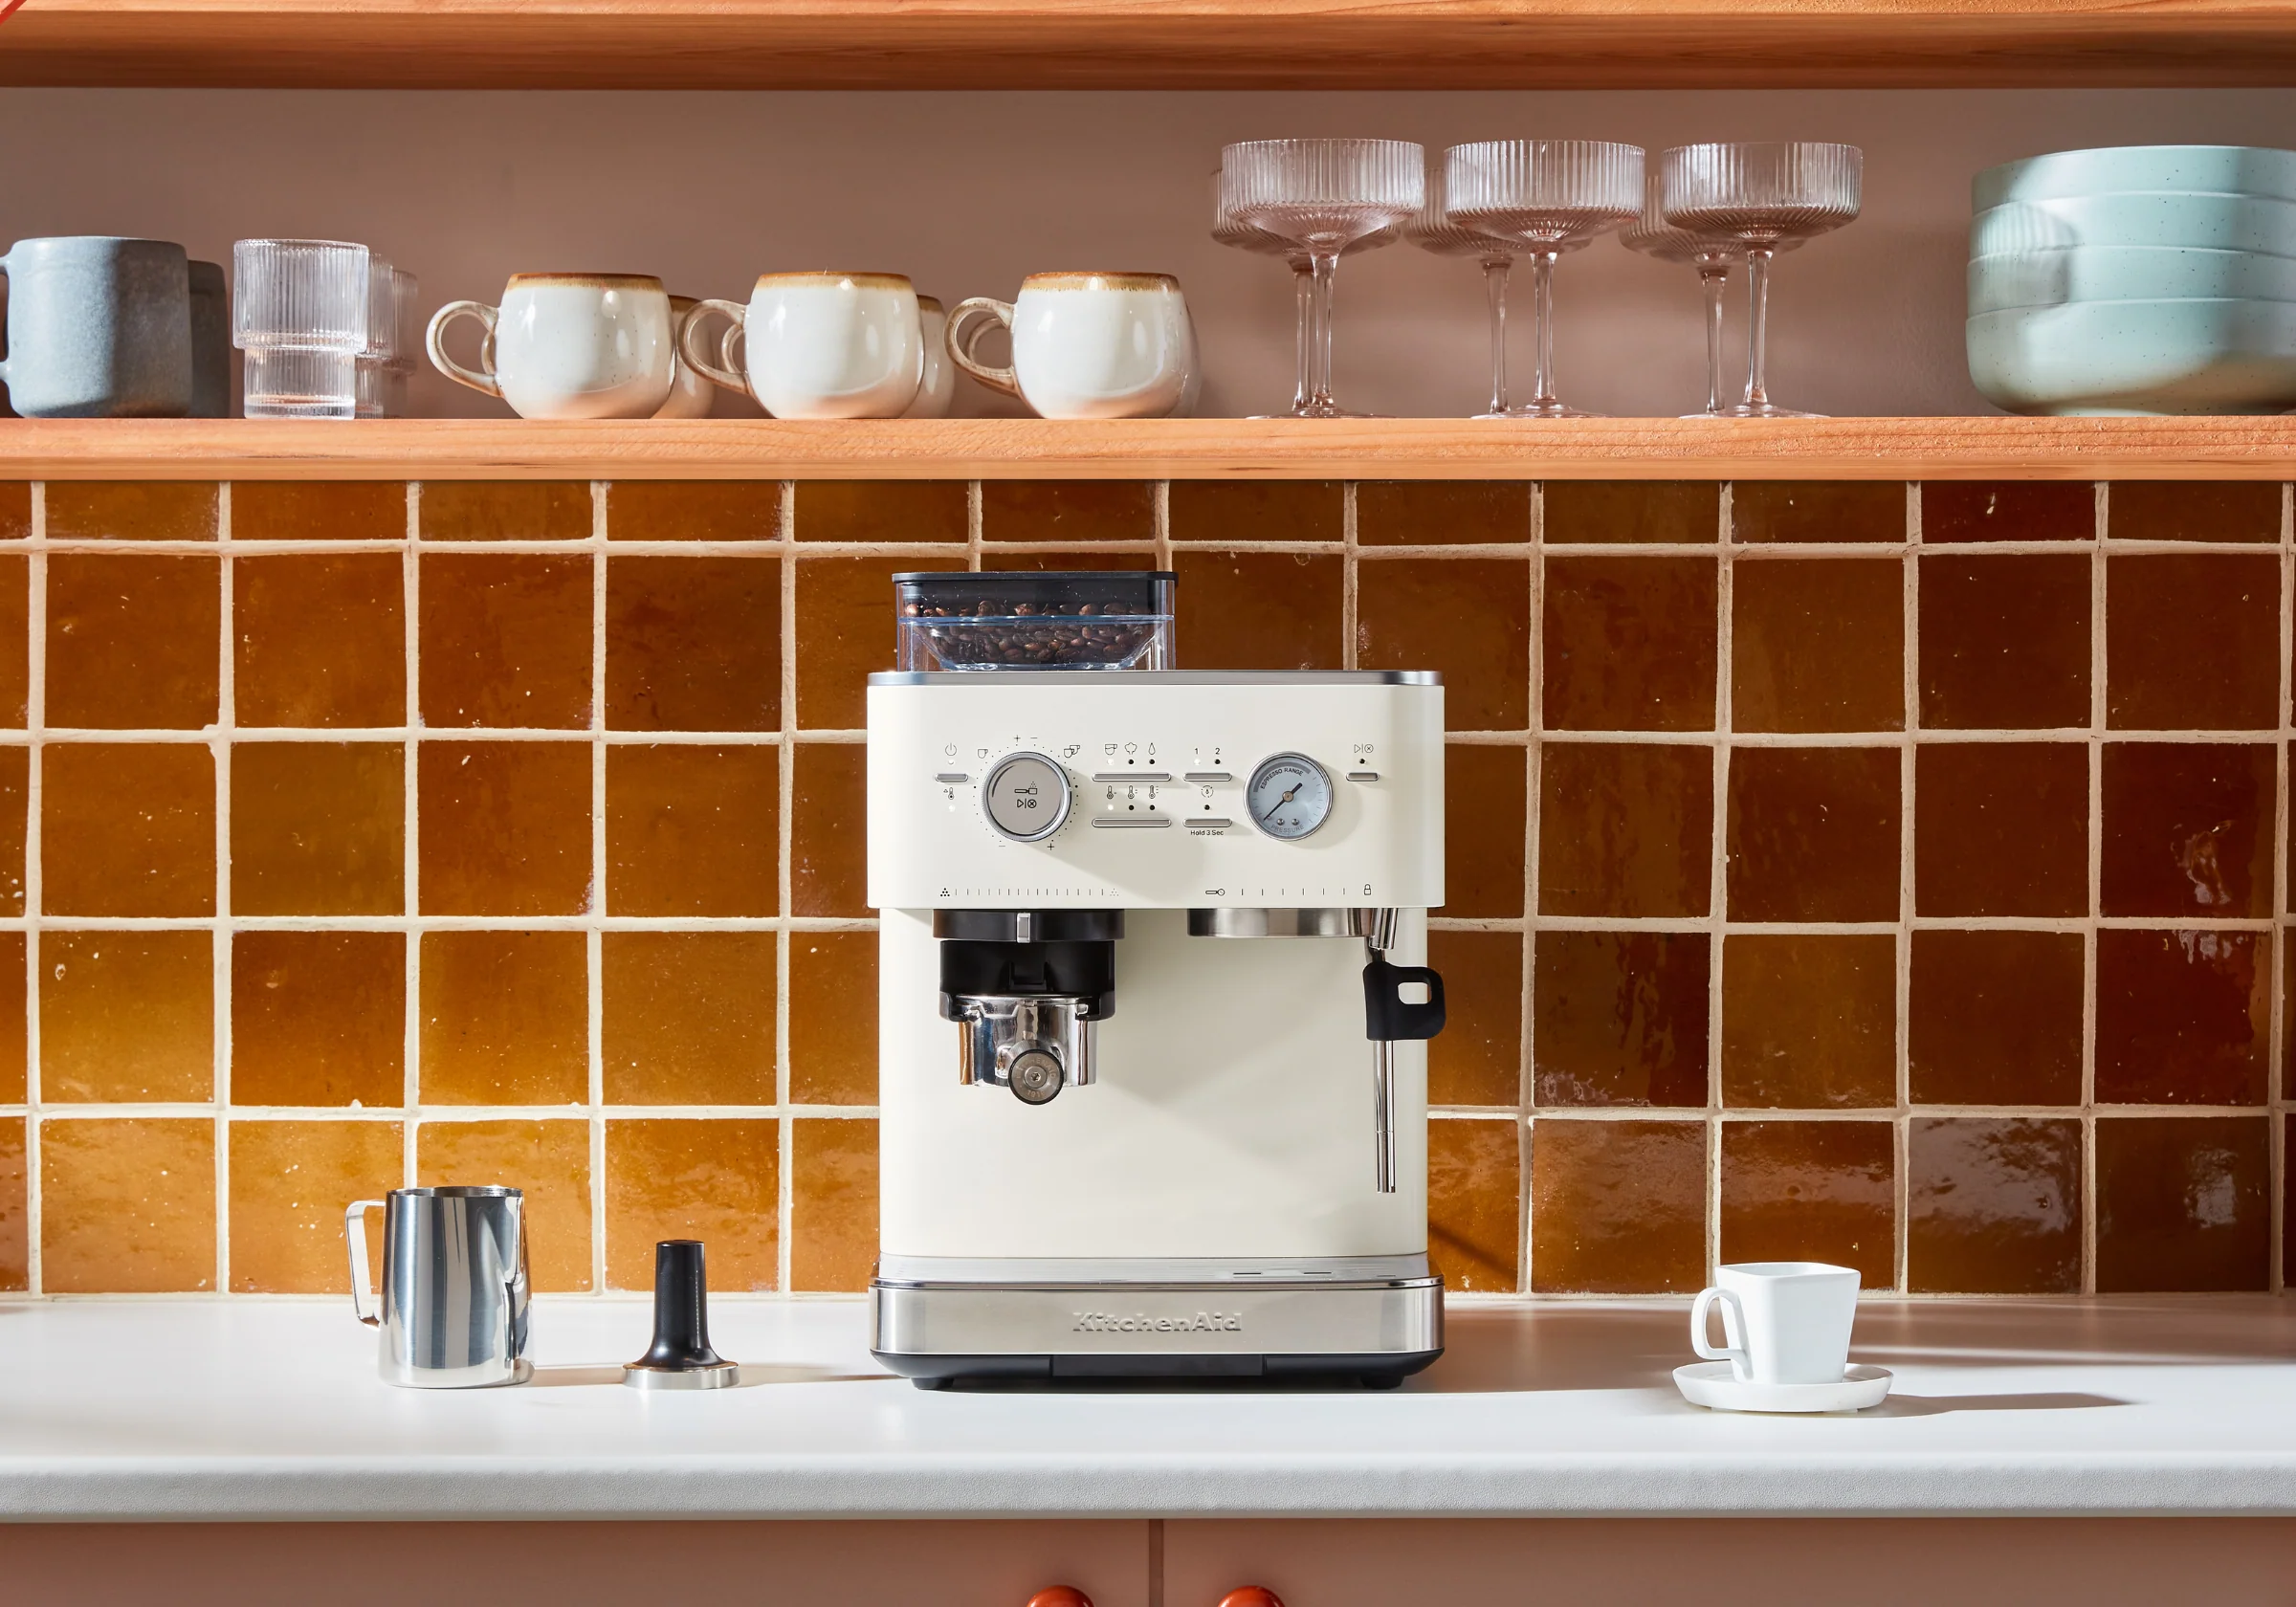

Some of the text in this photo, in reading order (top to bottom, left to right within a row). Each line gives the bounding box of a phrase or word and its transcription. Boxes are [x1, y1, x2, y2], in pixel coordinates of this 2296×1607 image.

[1260, 767, 1304, 790] ESPRESSO RANGE
[1270, 824, 1305, 833] PRESSURE
[1072, 1311, 1242, 1332] KitchenAid
